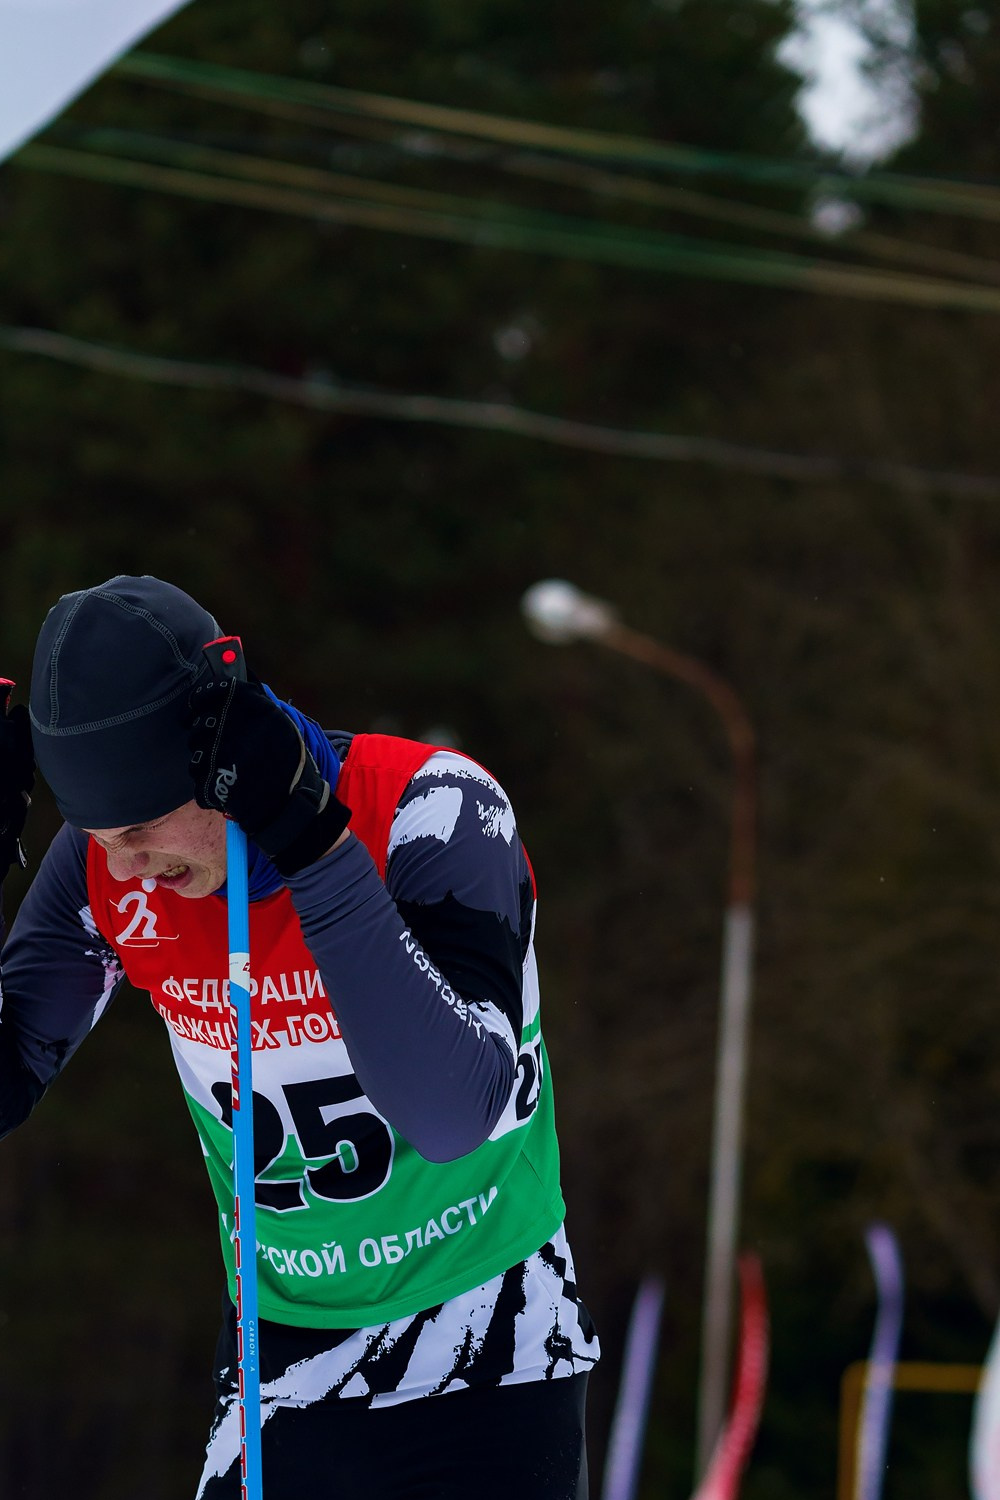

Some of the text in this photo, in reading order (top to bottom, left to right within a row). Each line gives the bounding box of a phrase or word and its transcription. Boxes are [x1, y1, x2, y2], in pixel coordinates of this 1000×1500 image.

[158, 1003, 278, 1048] ЛЫЖНХ
[161, 969, 326, 1014] ФЕДЕРАЦИ
[399, 930, 485, 1042] NORDSK
[514, 1042, 544, 1121] 2
[210, 1073, 393, 1212] 25
[256, 1185, 498, 1277] СКОЙ ОБЛАСТИ
[248, 1320, 256, 1356] CARBON
